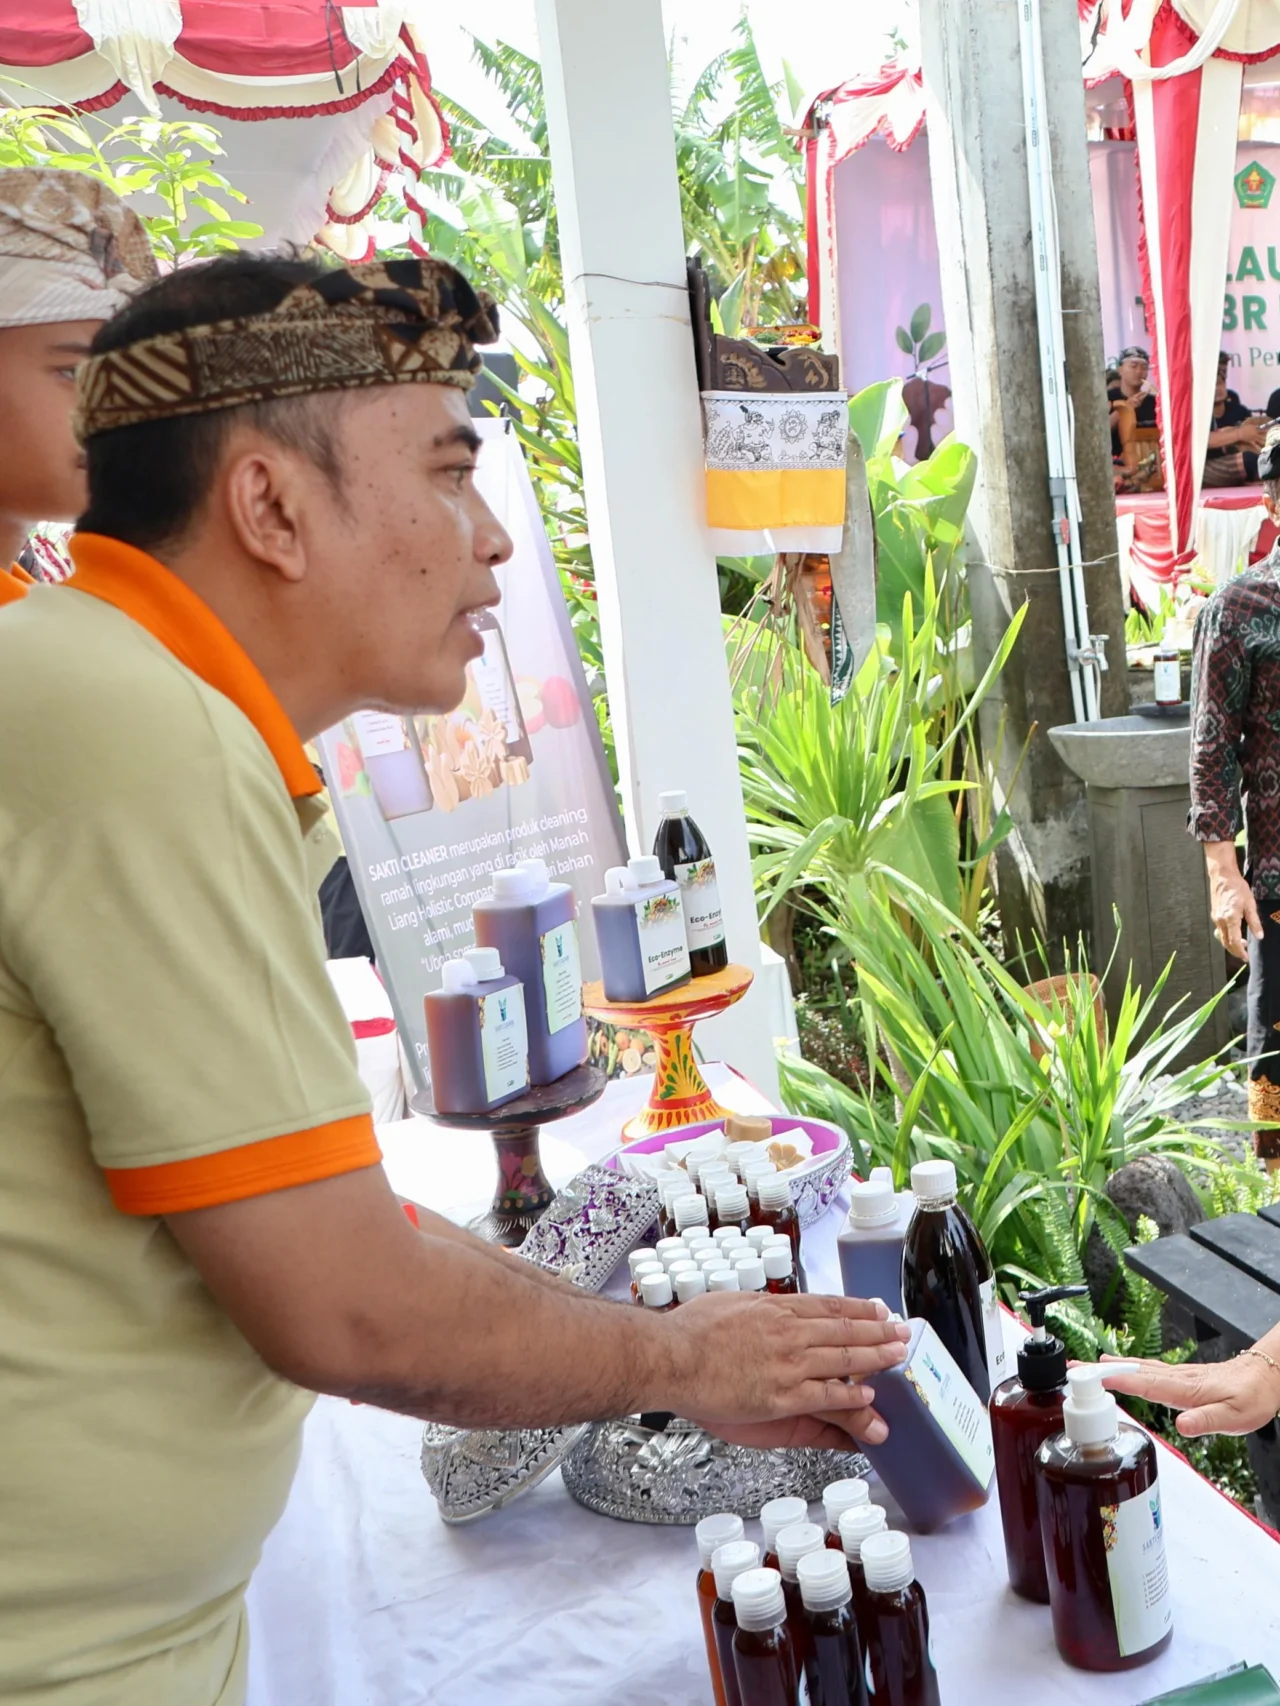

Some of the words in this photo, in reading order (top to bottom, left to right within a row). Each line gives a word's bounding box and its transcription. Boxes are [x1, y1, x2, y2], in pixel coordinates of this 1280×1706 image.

[368, 860, 400, 882] SAKTI
[400, 845, 449, 872] CLEANER
[449, 829, 504, 859] merupakan
[504, 820, 540, 846] produk
[540, 807, 588, 831] cleaning
[380, 880, 412, 907] ramah
[413, 868, 468, 897] lingkungan
[468, 860, 493, 882] yang
[493, 852, 503, 870] di
[530, 841, 550, 859] oleh
[549, 829, 589, 852] Manah
[387, 909, 418, 931] Liang
[418, 896, 454, 921] Holistic
[454, 883, 495, 909] Compan
[557, 853, 594, 876] bahan
[423, 925, 454, 947] alami,
[648, 945, 683, 963] Eco-Enzyme
